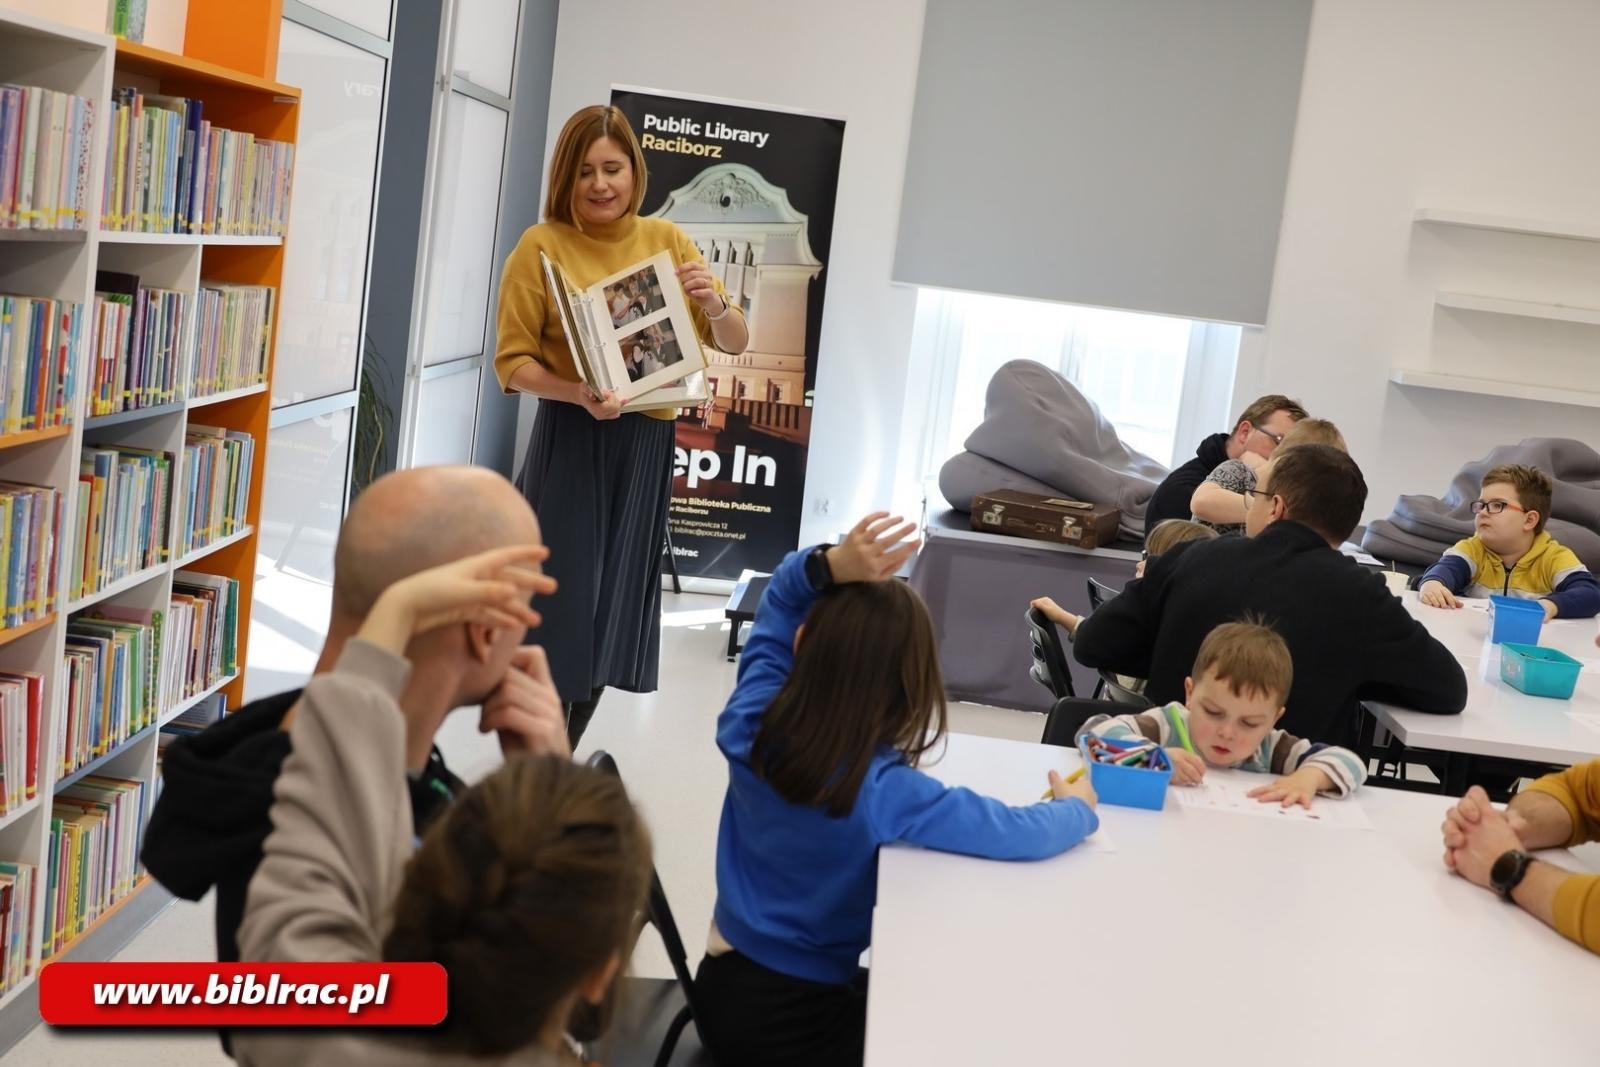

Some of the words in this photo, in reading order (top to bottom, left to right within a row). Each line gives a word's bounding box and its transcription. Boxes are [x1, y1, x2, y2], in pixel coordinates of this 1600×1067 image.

[643, 113, 701, 136] Public
[704, 122, 770, 149] Library
[641, 133, 723, 158] Raciborz
[732, 445, 777, 487] In
[675, 505, 709, 515] Raciborzu
[688, 497, 730, 509] Biblioteka
[731, 501, 772, 514] Publiczna
[681, 520, 720, 529] Kasprowicza
